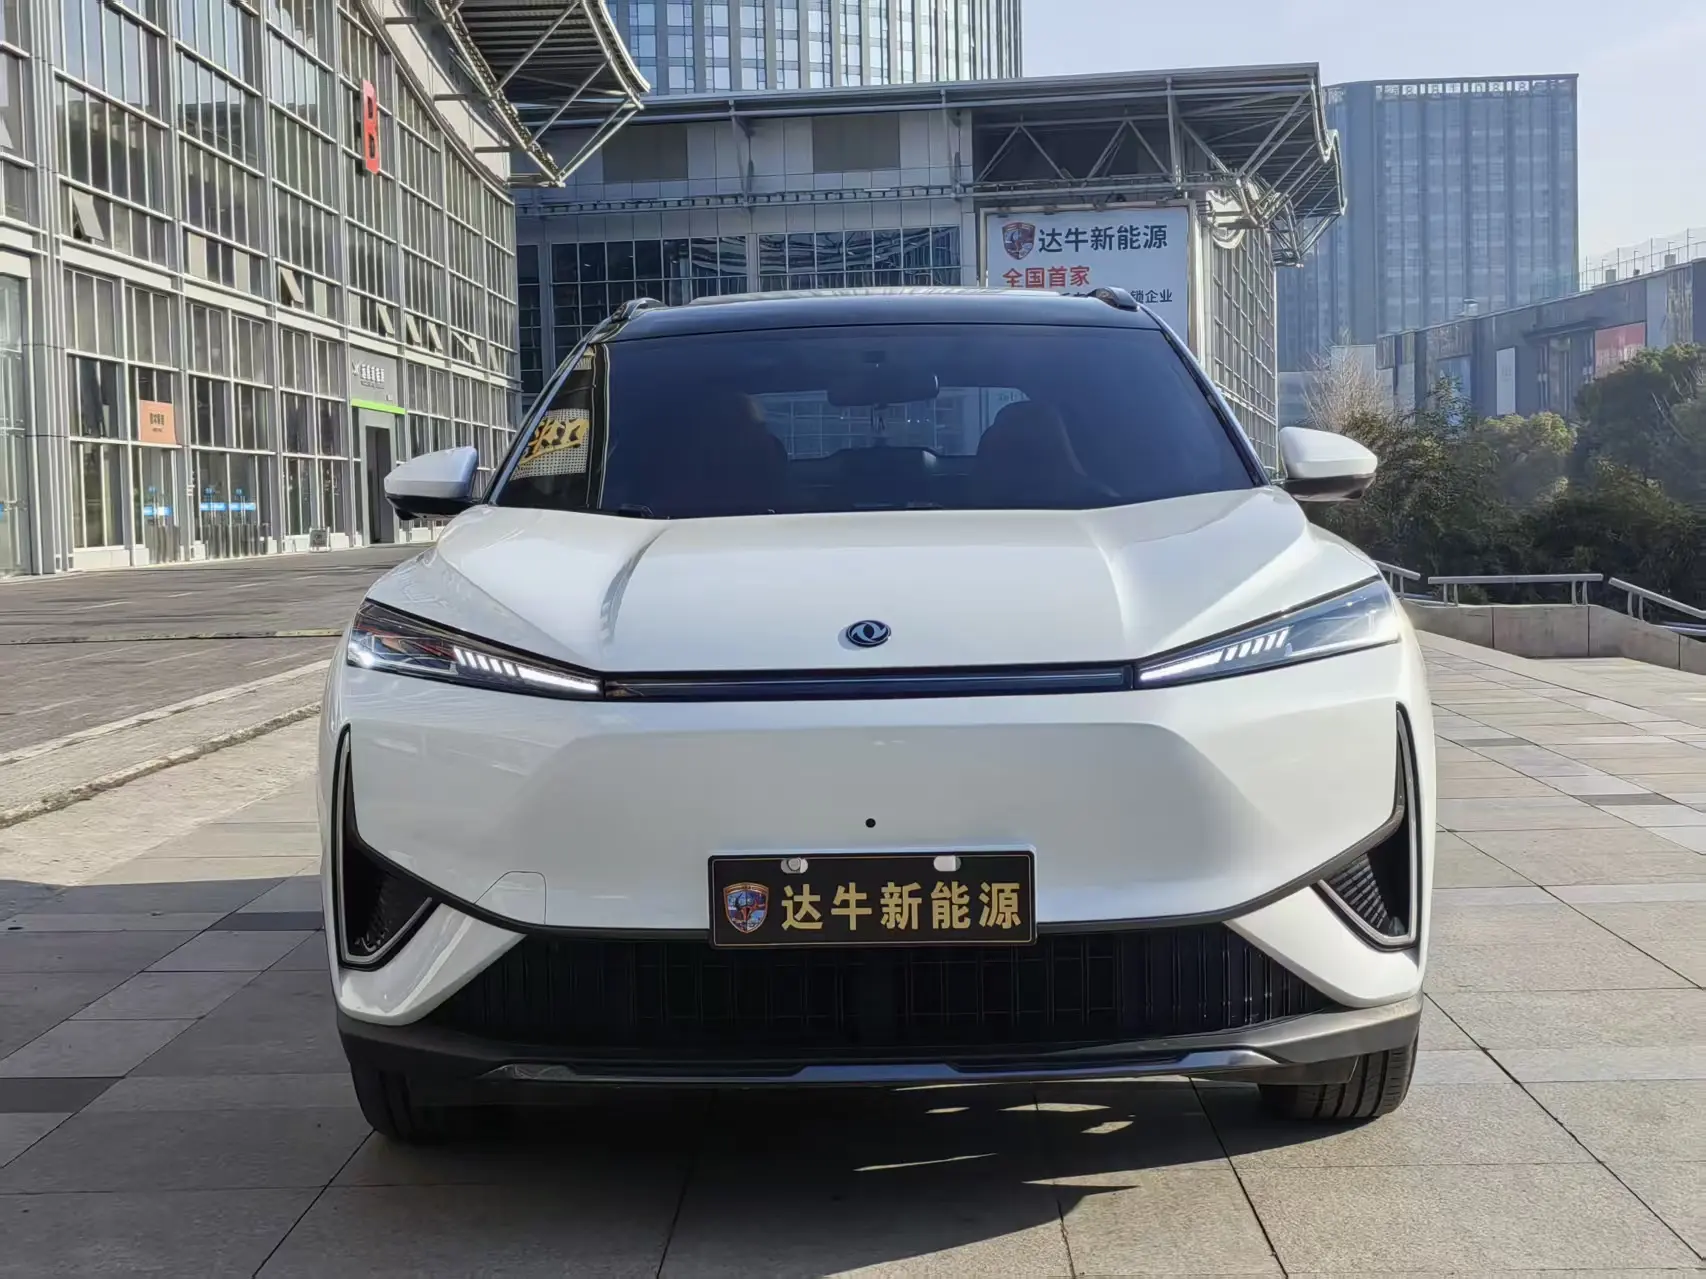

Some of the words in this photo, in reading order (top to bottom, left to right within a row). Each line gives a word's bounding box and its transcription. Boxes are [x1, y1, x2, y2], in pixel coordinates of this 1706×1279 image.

[1038, 224, 1168, 254] 达牛新能源
[1002, 265, 1091, 289] 全国首家
[780, 881, 1021, 931] 达牛新能源
